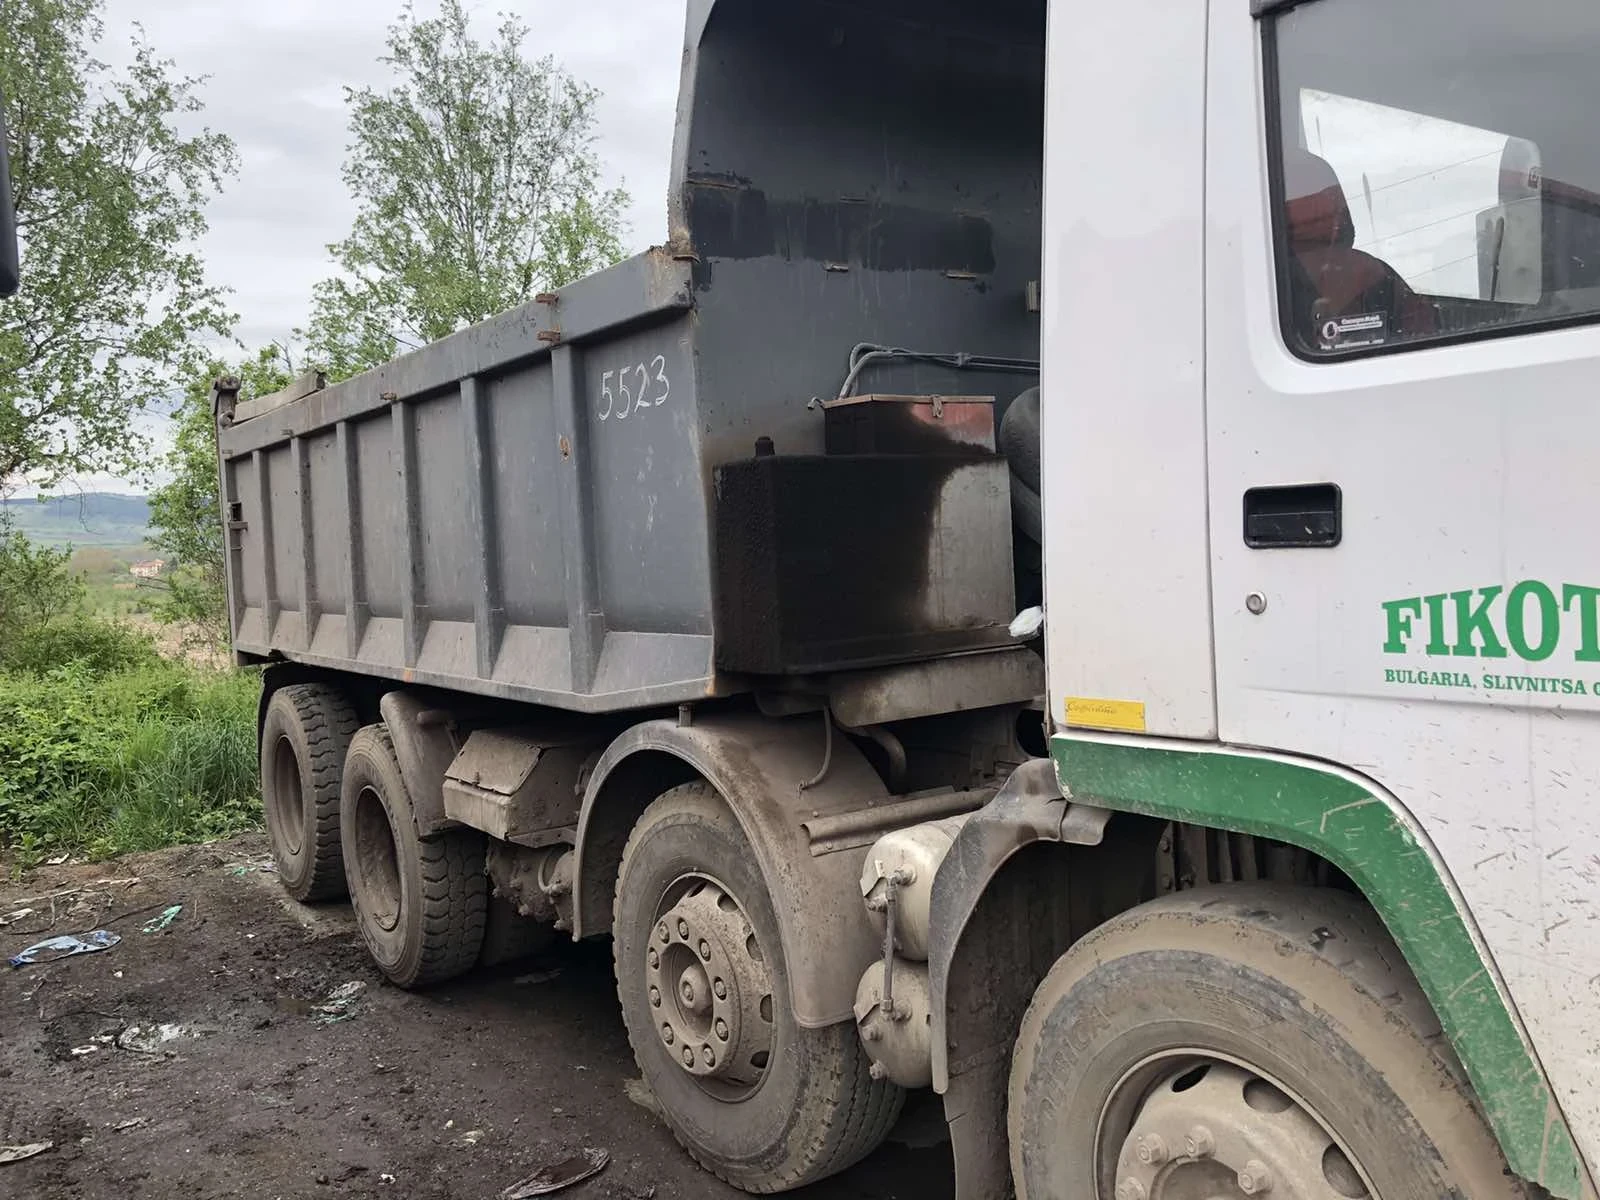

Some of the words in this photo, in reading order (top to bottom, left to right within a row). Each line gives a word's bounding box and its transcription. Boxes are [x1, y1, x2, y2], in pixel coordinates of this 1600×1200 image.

[599, 354, 669, 420] 5523
[1382, 579, 1600, 662] FIKOT
[1483, 674, 1588, 696] SLIVNITSA
